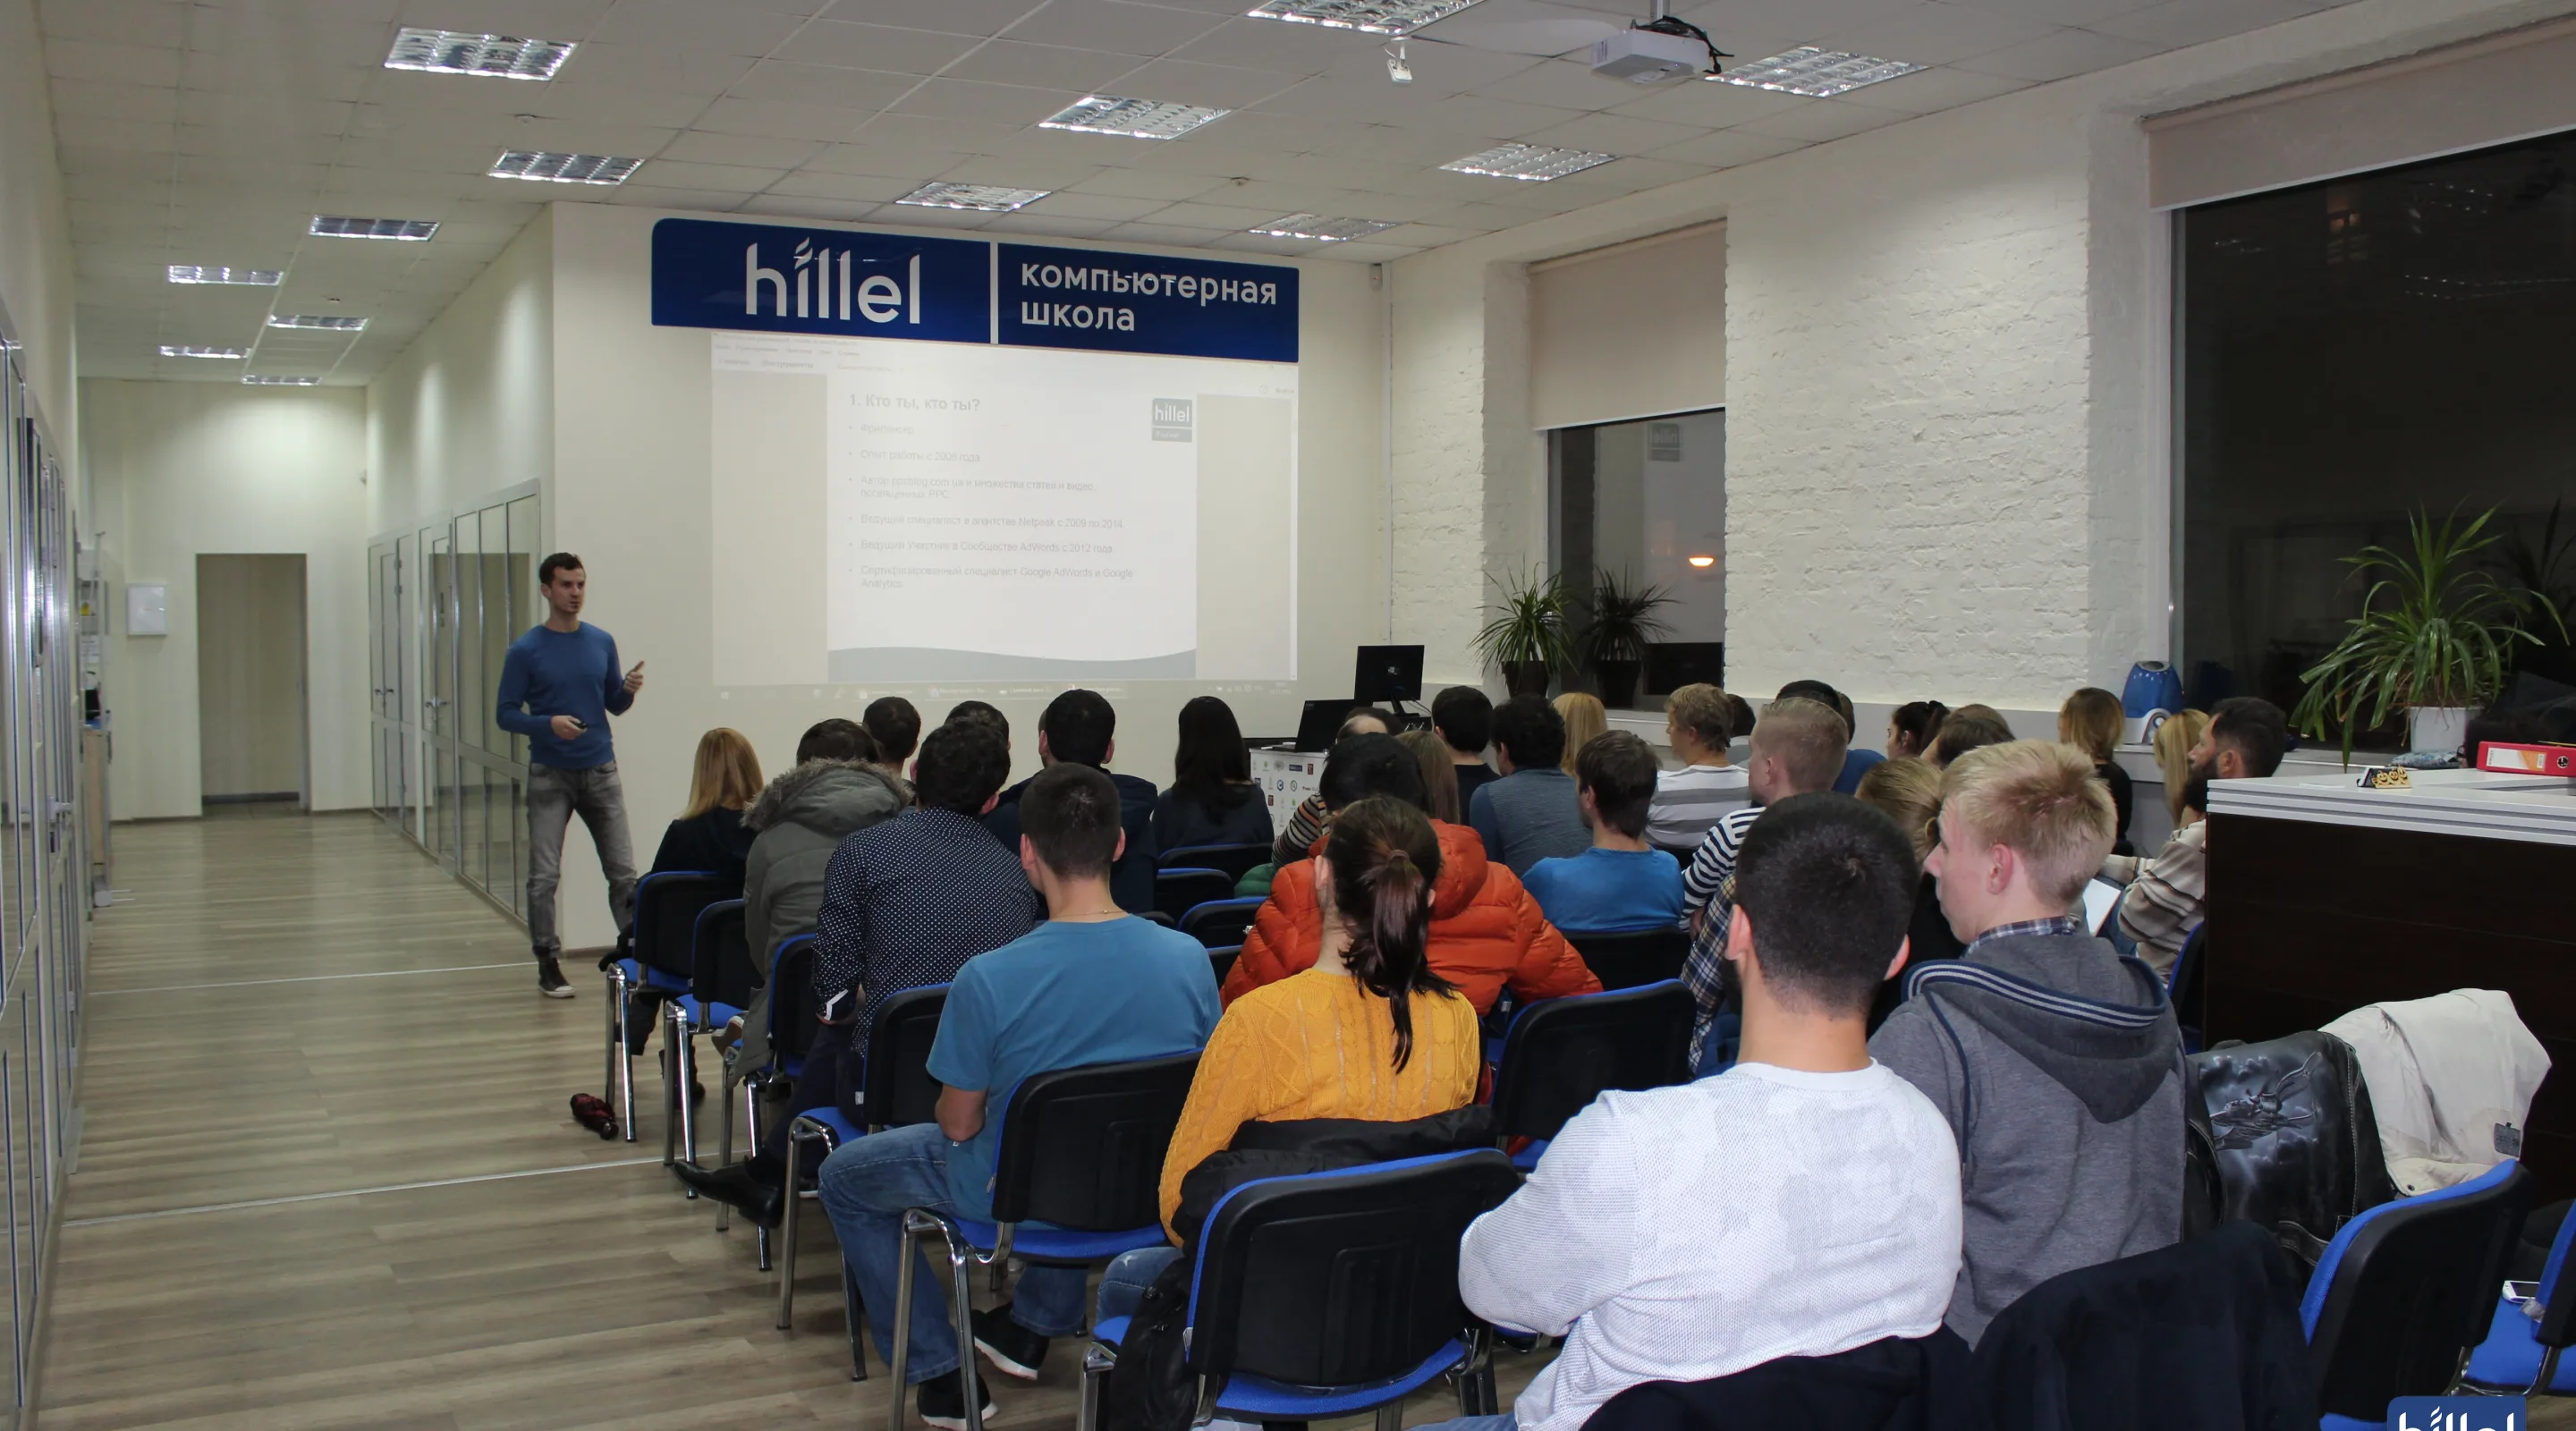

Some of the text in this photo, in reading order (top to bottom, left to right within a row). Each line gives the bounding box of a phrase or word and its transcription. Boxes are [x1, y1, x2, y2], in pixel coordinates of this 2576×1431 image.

[746, 237, 919, 324] hillel
[1021, 263, 1276, 306] компьютерная
[1021, 301, 1135, 331] школа
[850, 394, 980, 411] 1. Кто ты, кто ты?
[1155, 402, 1190, 423] hillel
[860, 449, 887, 461] Опыт
[890, 450, 924, 462] работы
[935, 451, 958, 461] 2008
[959, 453, 980, 463] года
[861, 476, 888, 487] Автор
[975, 480, 1024, 489] множества
[861, 513, 904, 525] Ведущий
[907, 515, 961, 526] специалист
[971, 518, 1016, 526] агентстве
[1019, 517, 1055, 529] Netpeak
[1064, 518, 1087, 528] 2009
[1089, 521, 1099, 529] по
[861, 538, 904, 551] Ведущий
[961, 541, 1018, 553] Сообществе
[1020, 542, 1060, 553] AdWords
[1070, 543, 1091, 553] 2012
[964, 567, 1017, 578] специалист
[1021, 567, 1051, 579] Google
[1053, 568, 1092, 578] AdWords
[1103, 569, 1133, 580] Google
[861, 579, 904, 590] Analytics
